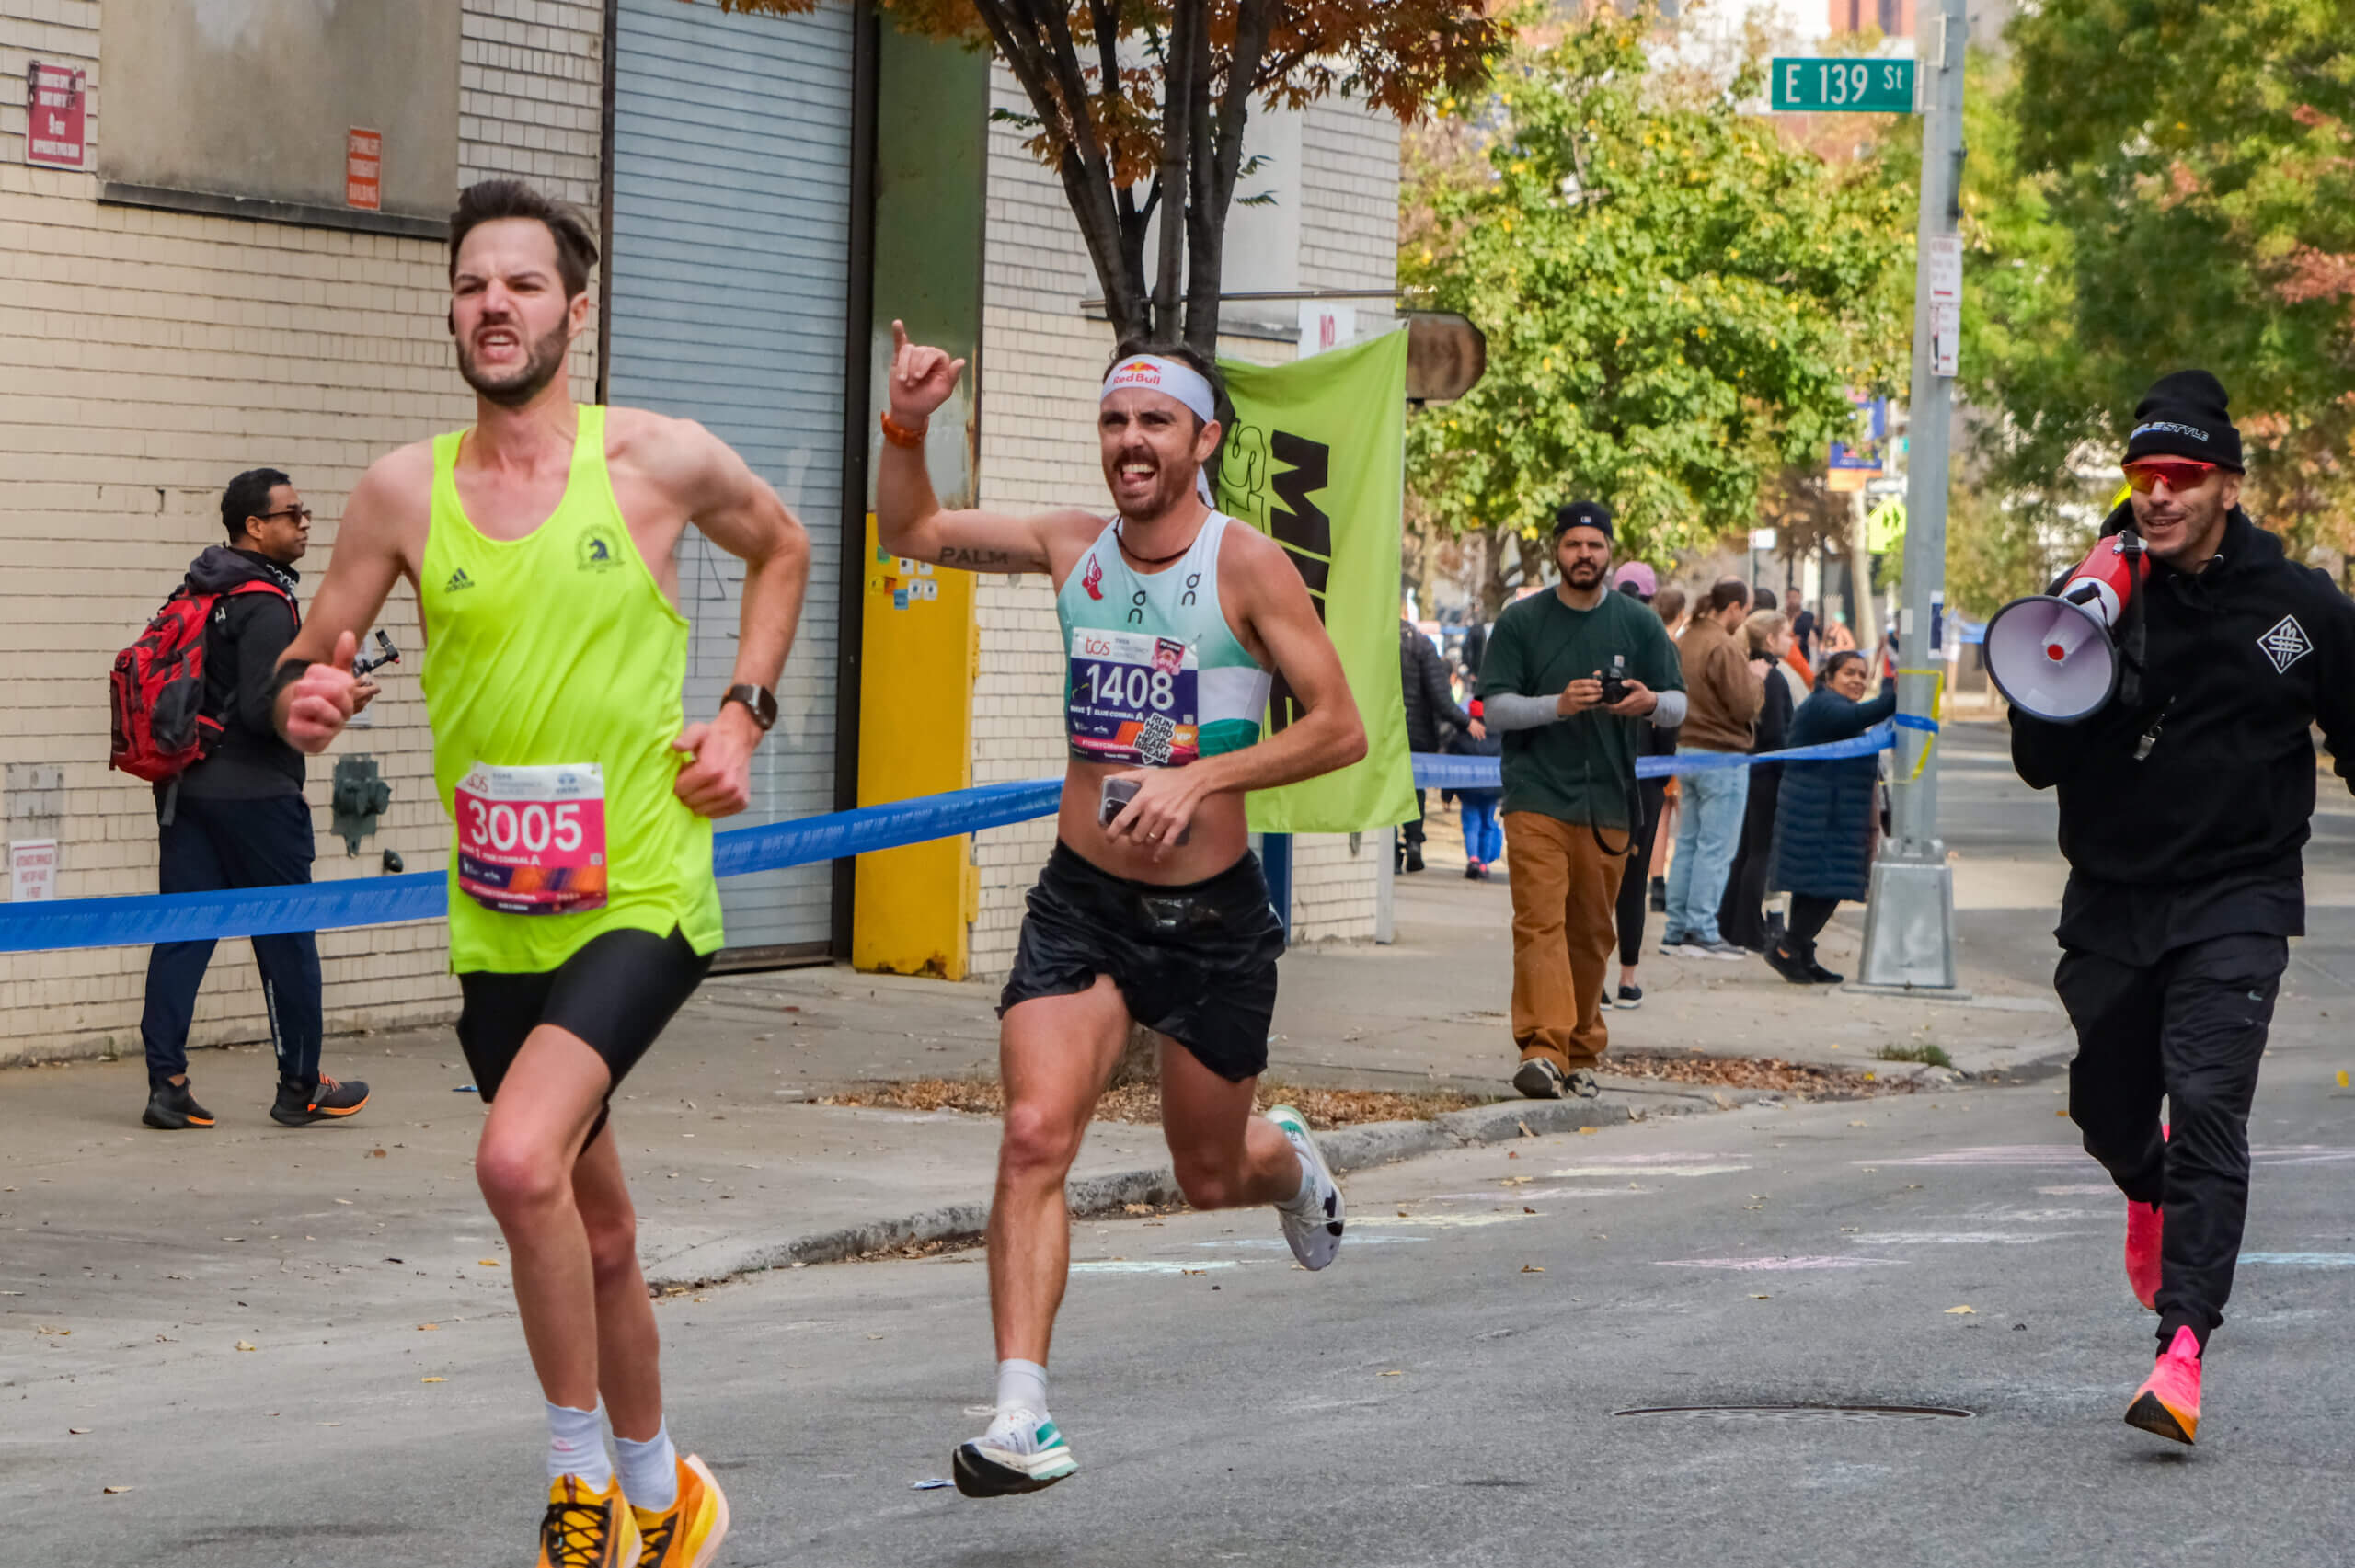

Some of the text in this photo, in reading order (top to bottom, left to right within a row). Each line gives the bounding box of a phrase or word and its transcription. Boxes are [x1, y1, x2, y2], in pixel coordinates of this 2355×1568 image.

[1786, 64, 1902, 104] E 139 St
[1320, 314, 1335, 349] NO
[1113, 373, 1161, 384] Red Bull
[940, 546, 1008, 565] PALM
[1086, 636, 1110, 656] tcs
[1086, 663, 1175, 711] 1408
[1135, 711, 1143, 722] A
[1152, 714, 1174, 729] RUN
[1144, 728, 1167, 744] RISK
[1145, 720, 1173, 738] HARD
[1177, 733, 1192, 741] VIP
[1134, 741, 1167, 762] BREAK
[1138, 733, 1170, 752] HEART
[468, 799, 582, 853] 3005
[531, 855, 541, 866] A
